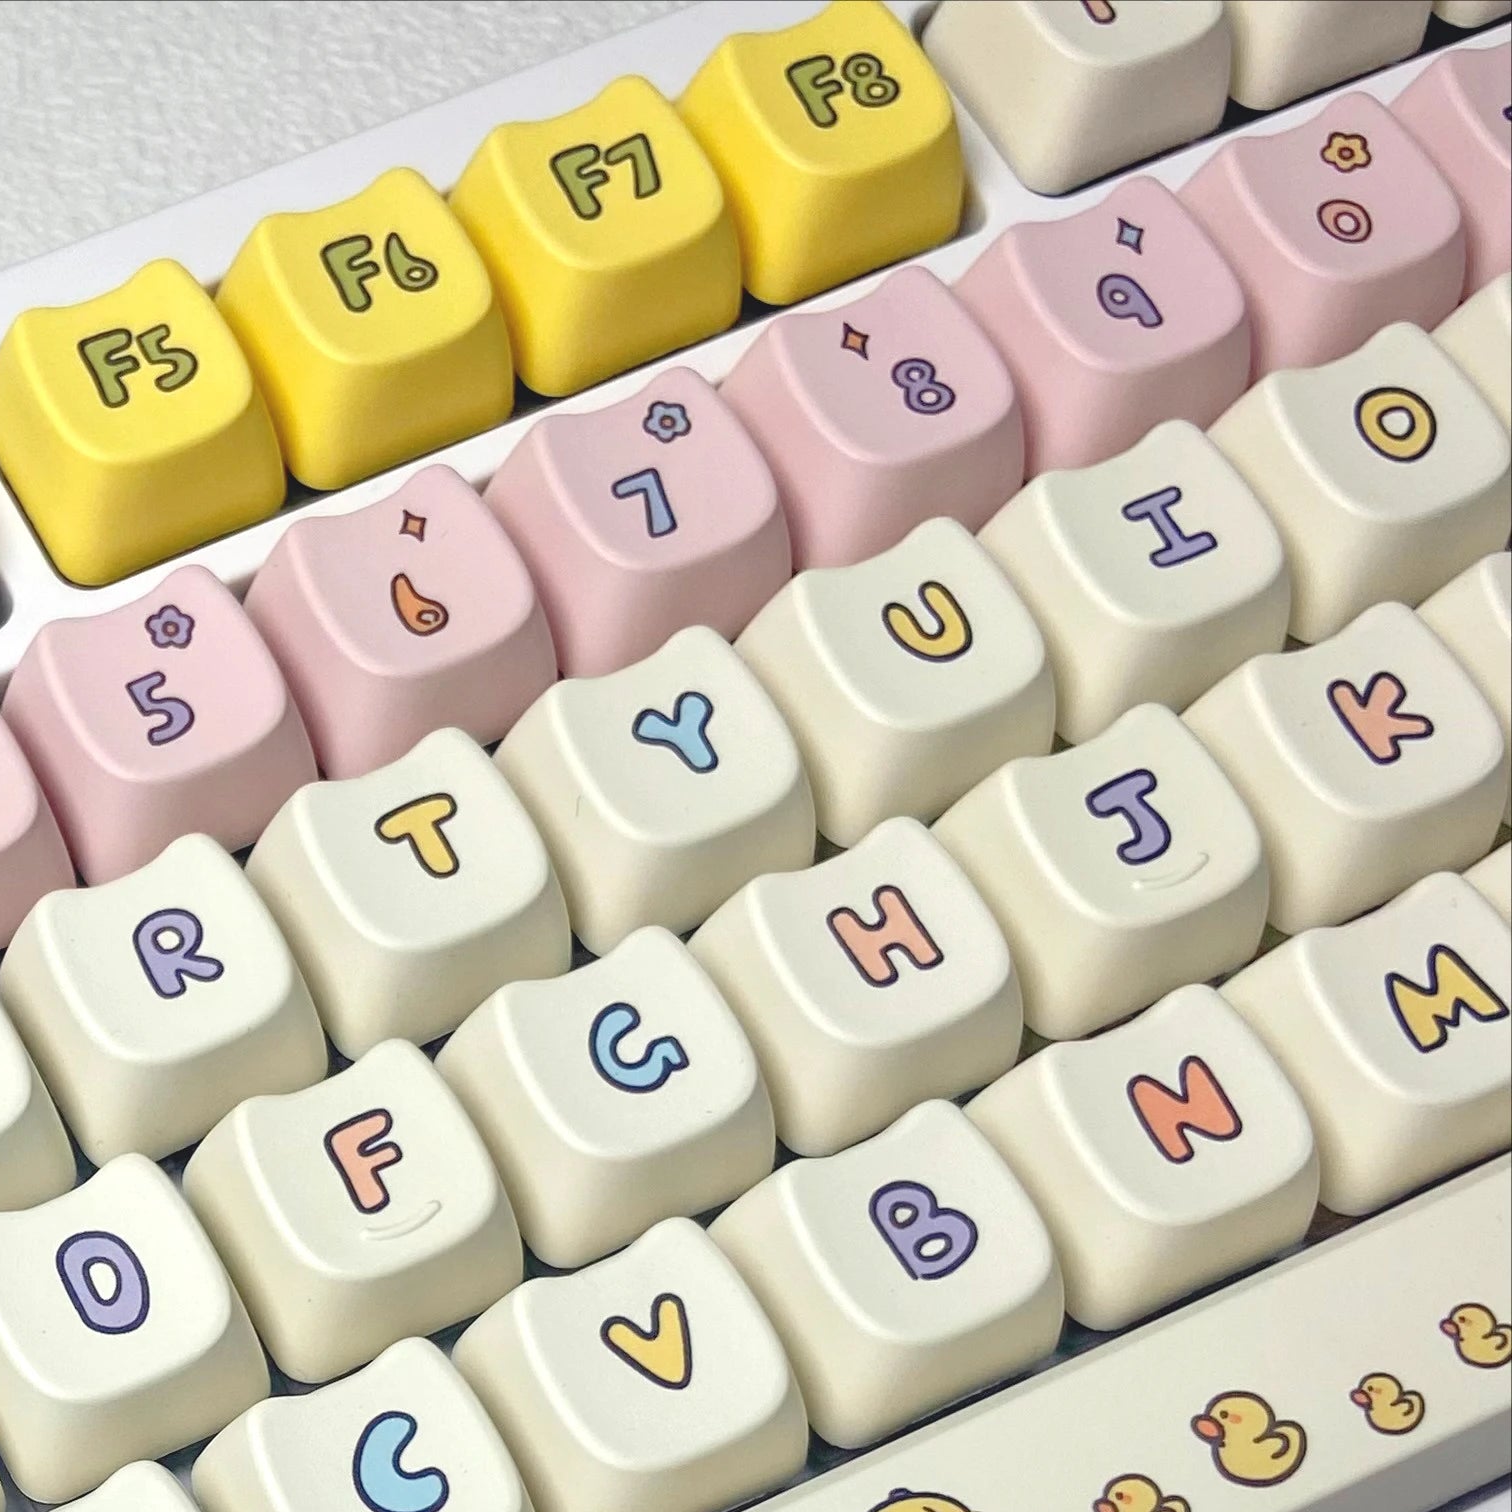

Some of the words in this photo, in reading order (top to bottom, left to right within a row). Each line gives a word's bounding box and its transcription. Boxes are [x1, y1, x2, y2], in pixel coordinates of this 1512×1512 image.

[785, 52, 901, 129] F8
[549, 132, 662, 221] F7
[319, 231, 439, 313] F6
[1096, 273, 1164, 329] 9
[77, 323, 199, 409] F5
[891, 357, 957, 415] 8
[1354, 386, 1438, 463] O
[611, 467, 678, 539] 7
[1121, 485, 1218, 568] I
[390, 572, 450, 637] 6
[881, 580, 974, 663] U
[125, 670, 196, 746] 5
[631, 691, 719, 774] Y
[1326, 671, 1435, 766] K
[374, 792, 460, 879] T
[1085, 768, 1172, 866] J
[132, 907, 225, 1000] R
[826, 884, 945, 988] H
[1384, 943, 1510, 1054] M
[588, 1001, 690, 1094] G
[1126, 1055, 1243, 1165] N
[323, 1108, 404, 1215] F
[868, 1180, 979, 1281] B
[599, 1292, 693, 1391] V
